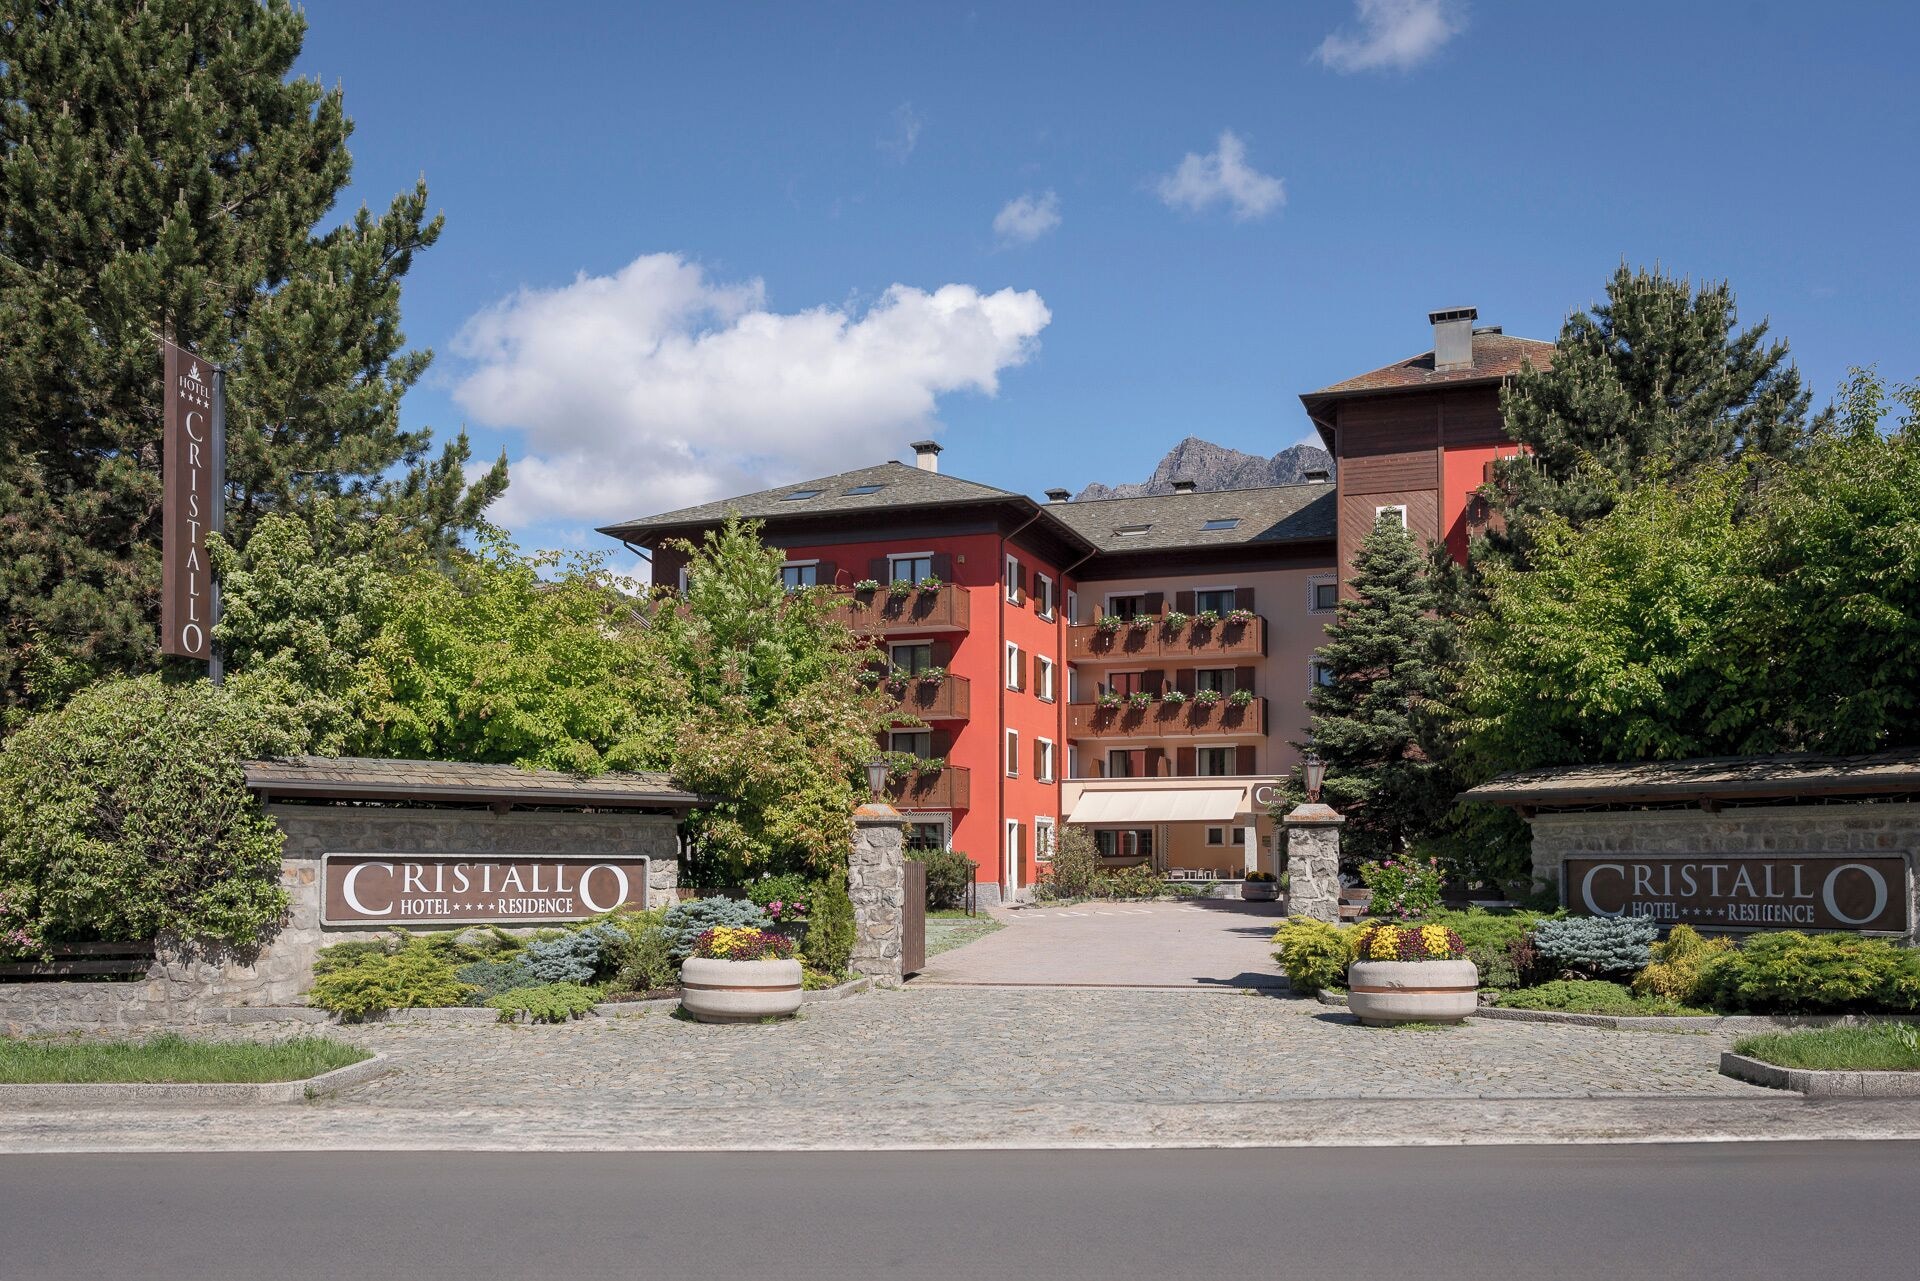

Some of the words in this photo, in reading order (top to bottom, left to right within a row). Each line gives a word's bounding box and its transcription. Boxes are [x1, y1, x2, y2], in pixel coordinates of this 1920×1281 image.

[179, 375, 210, 399] HOTEL
[182, 411, 203, 653] CRISTALLO
[342, 861, 629, 915] CRISTALLO
[400, 899, 451, 915] HOTEL
[498, 898, 573, 915] RESIDENCE
[1581, 863, 1888, 925] CRISTALLO
[1631, 901, 1680, 919] HOTEL
